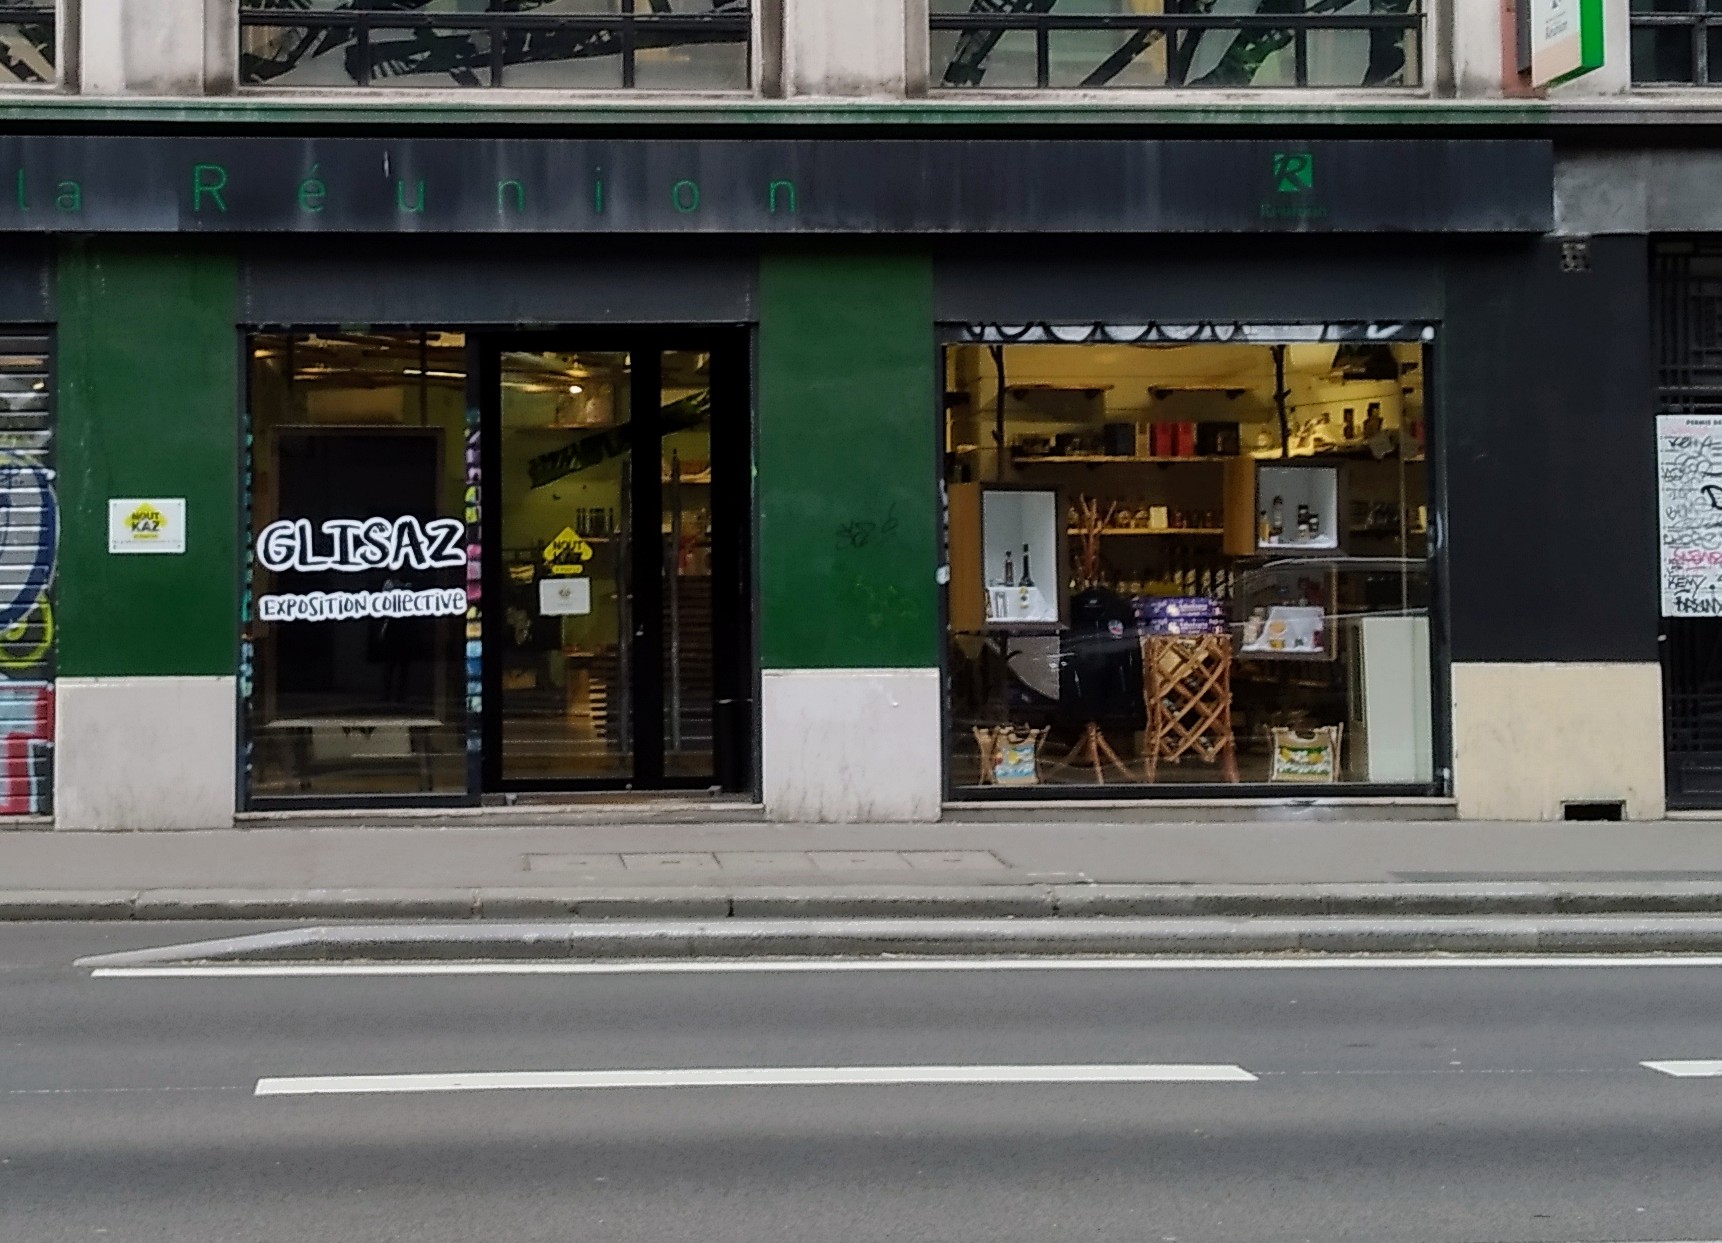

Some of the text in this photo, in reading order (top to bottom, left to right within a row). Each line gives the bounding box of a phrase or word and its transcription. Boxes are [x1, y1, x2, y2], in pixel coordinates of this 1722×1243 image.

[192, 163, 799, 214] Réunion
[132, 512, 160, 520] NOUT
[132, 520, 160, 532] KAZ
[259, 517, 465, 571] GLISAZ
